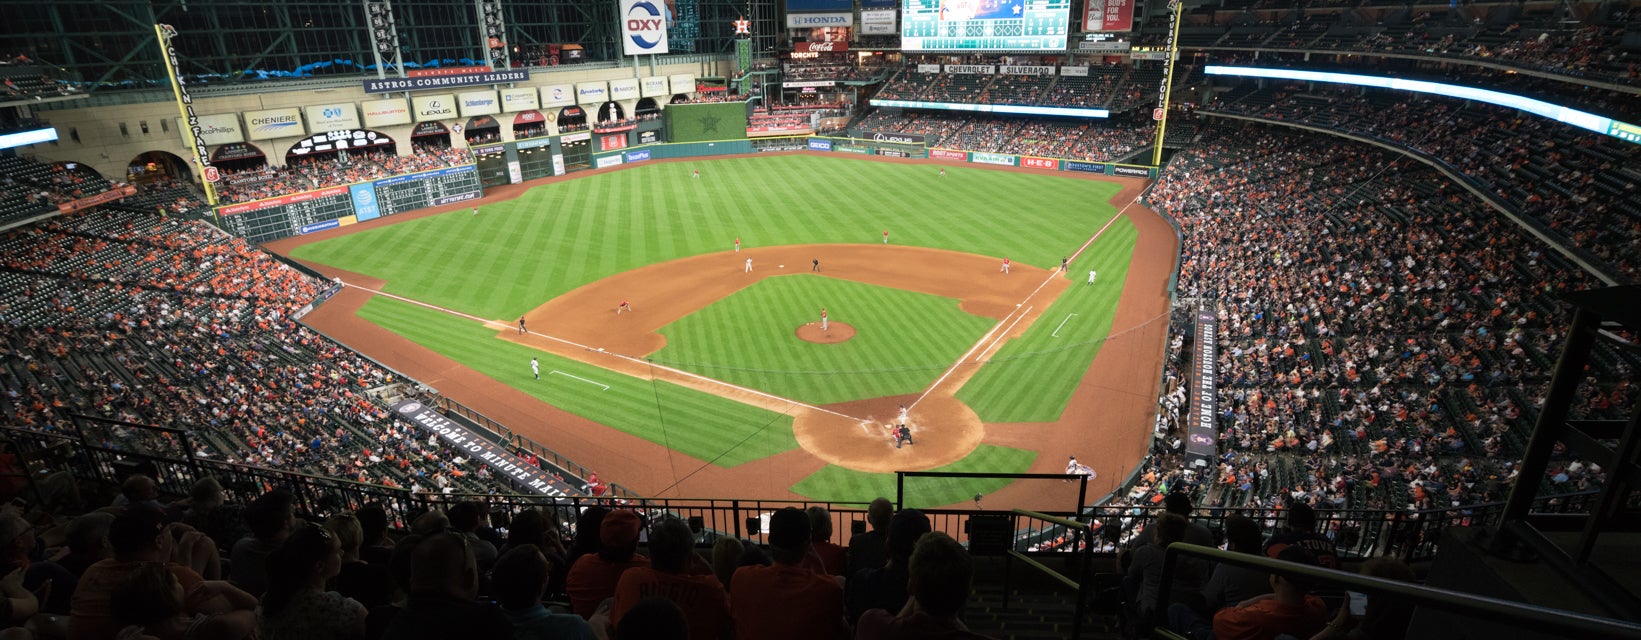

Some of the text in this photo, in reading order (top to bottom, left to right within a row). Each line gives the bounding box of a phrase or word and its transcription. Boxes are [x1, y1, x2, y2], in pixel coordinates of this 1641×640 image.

[803, 16, 847, 24] HONDA
[1106, 14, 1120, 22] YOU.
[627, 19, 662, 32] OXY
[1163, 14, 1175, 67] BURGERZ
[948, 66, 991, 74] CHEVROLET
[1006, 66, 1049, 75] SILVERADO
[416, 75, 480, 87] COMMUNITY
[484, 72, 525, 82] LEADERS
[1158, 77, 1167, 108] FOUL
[168, 47, 210, 166] CHIKIN IZ FARE
[420, 107, 452, 116] LEXUS
[251, 115, 297, 126] CHENIERE
[1027, 158, 1053, 167] H-E-B
[1115, 167, 1147, 175] POWERADE
[358, 206, 376, 215] AT&T
[1200, 324, 1213, 428] HOME OF THE HOUSTON ASTROS
[413, 413, 467, 445] WELCOME
[463, 441, 482, 453] TO
[480, 450, 531, 481] MINUTE
